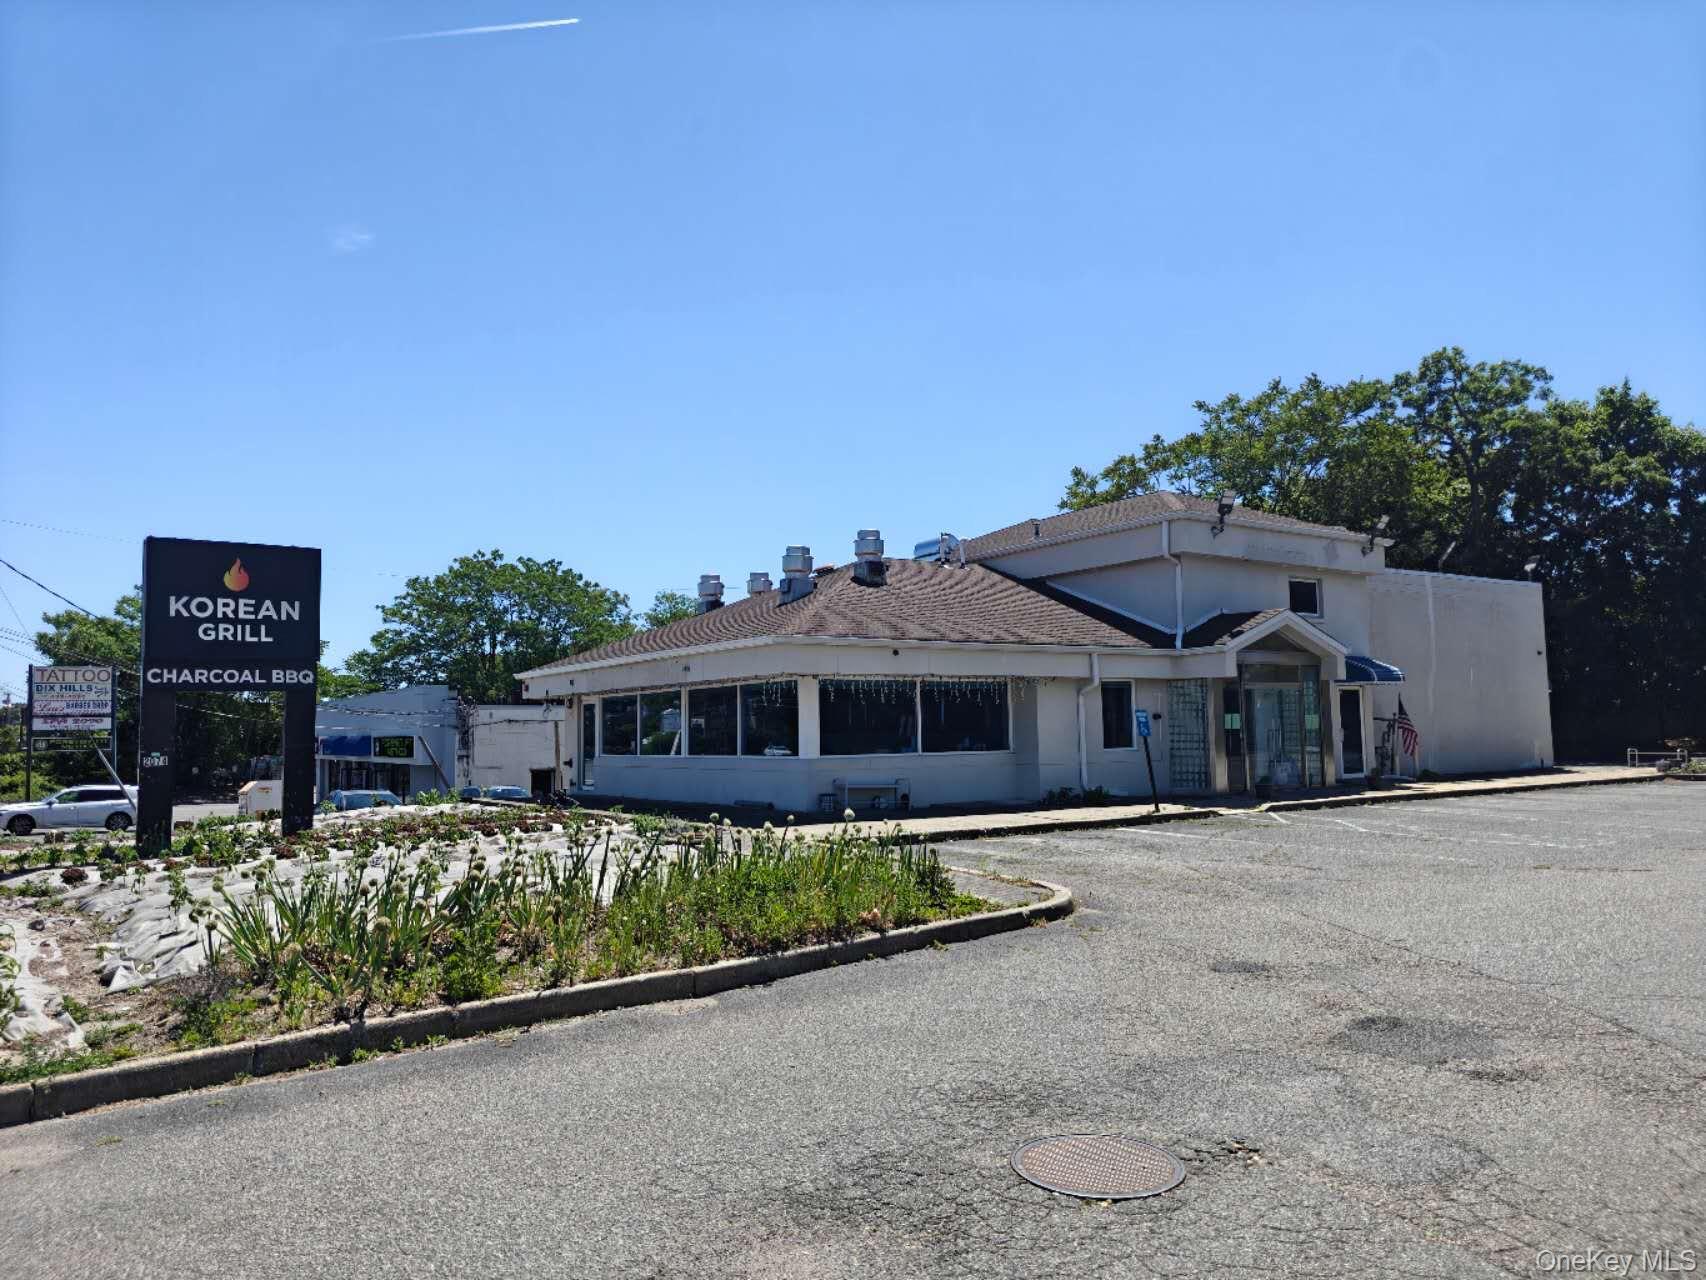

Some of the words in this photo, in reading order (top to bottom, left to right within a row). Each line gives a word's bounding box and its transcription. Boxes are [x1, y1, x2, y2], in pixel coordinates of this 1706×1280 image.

[169, 595, 300, 621] KOREAN
[198, 623, 274, 643] GRILL
[35, 668, 111, 682] TATTOO
[146, 668, 267, 684] CHARCOAL
[271, 670, 314, 684] BBQ
[35, 684, 56, 692] DIX
[59, 684, 93, 692] HILLS
